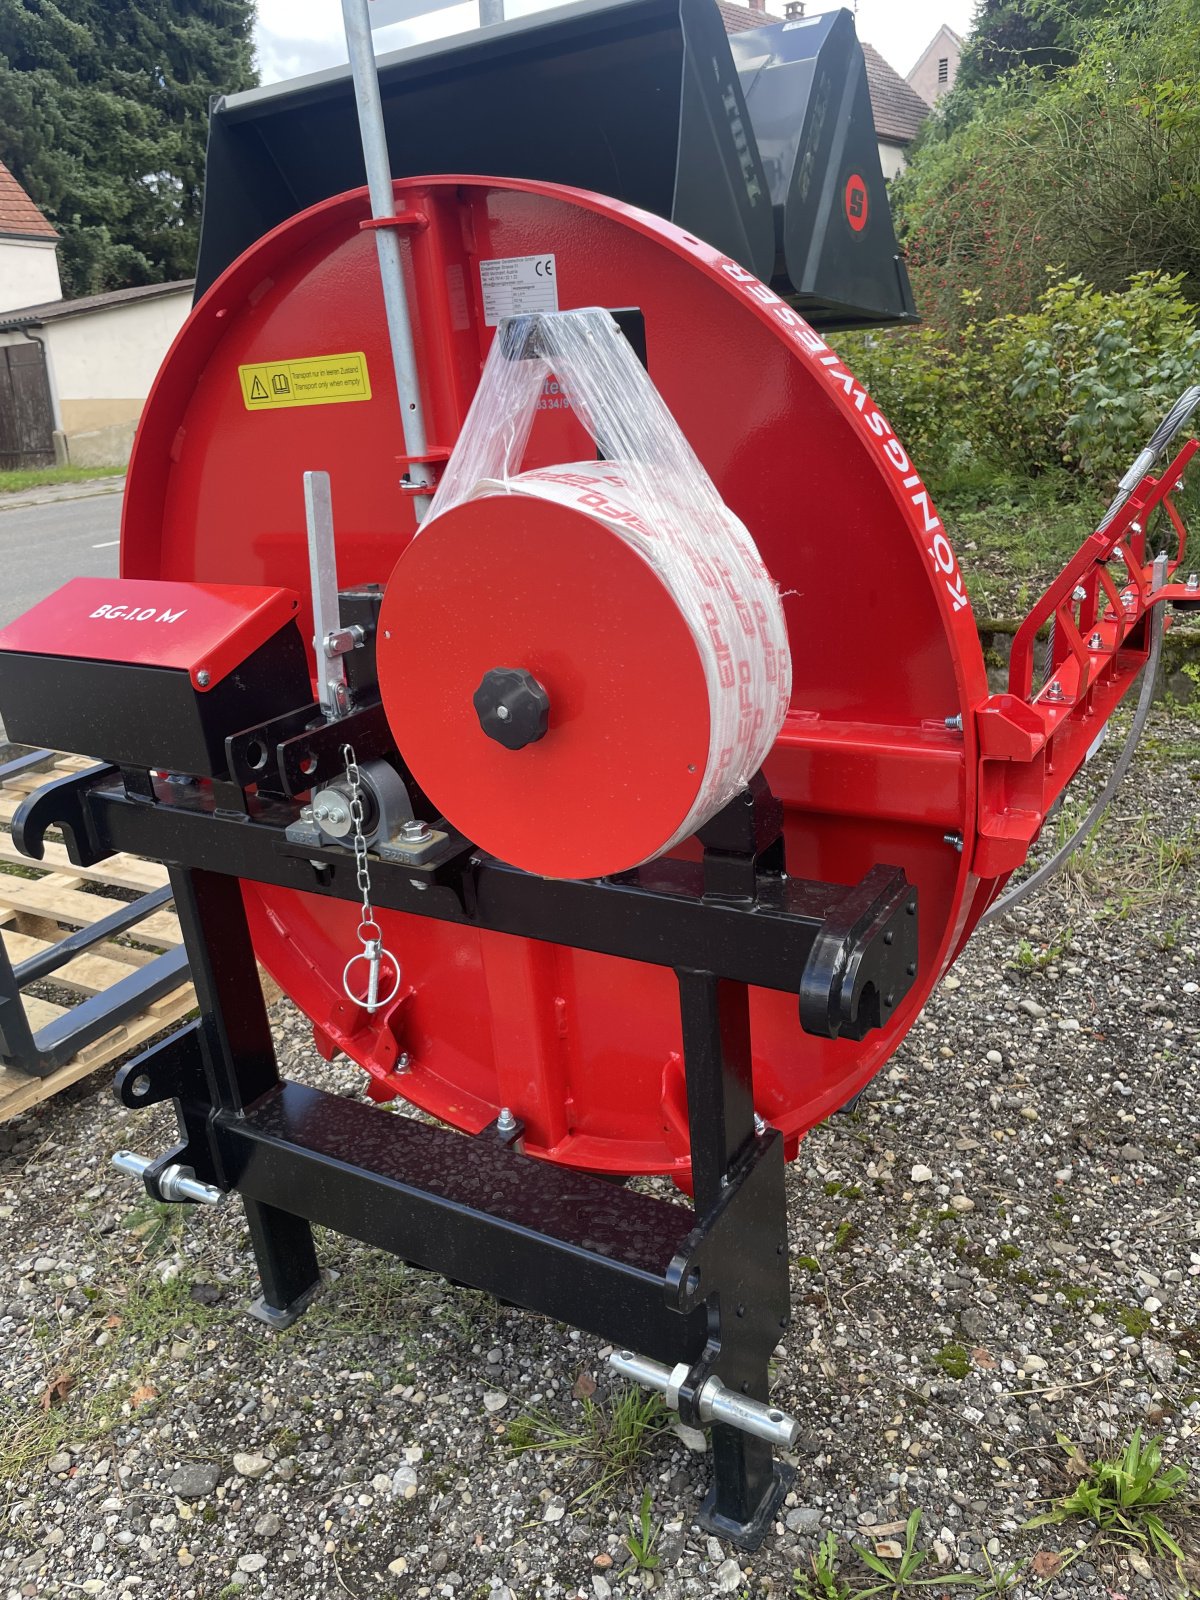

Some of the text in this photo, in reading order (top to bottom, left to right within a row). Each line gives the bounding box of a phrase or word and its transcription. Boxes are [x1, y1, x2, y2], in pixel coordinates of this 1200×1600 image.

[292, 371, 311, 380] Transport
[340, 367, 359, 375] Zustand
[295, 383, 317, 391] Transport
[318, 381, 328, 389] only
[344, 378, 360, 387] empty
[722, 264, 968, 612] KÖNIGSWIESER
[155, 608, 188, 624] M
[701, 602, 736, 689] EIFO
[738, 660, 753, 745] EIFO
